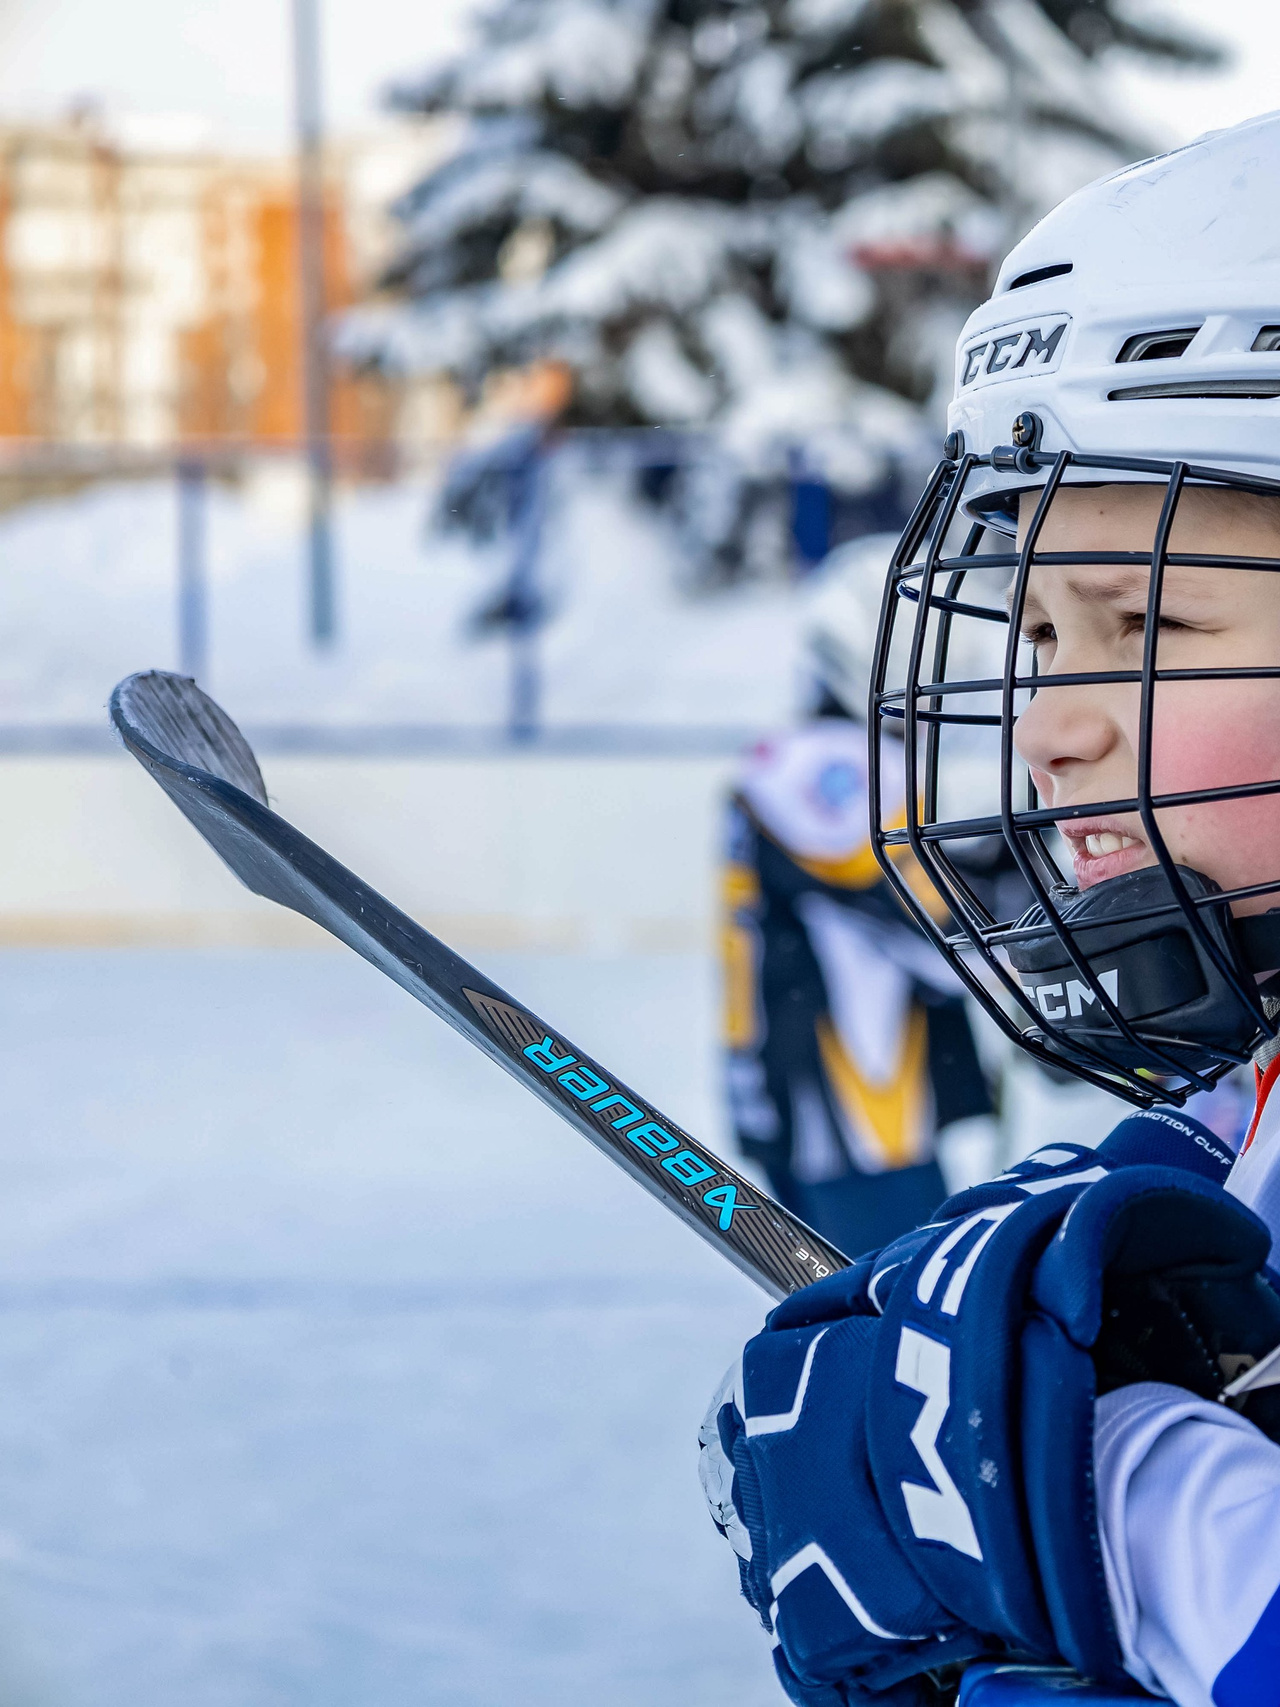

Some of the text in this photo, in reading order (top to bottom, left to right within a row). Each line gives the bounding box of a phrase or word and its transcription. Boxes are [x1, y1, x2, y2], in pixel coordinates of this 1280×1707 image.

[962, 323, 1067, 386] CCM
[522, 1035, 717, 1187] BAUER
[1194, 1135, 1233, 1165] CUFF
[796, 1247, 832, 1278] ÔLE
